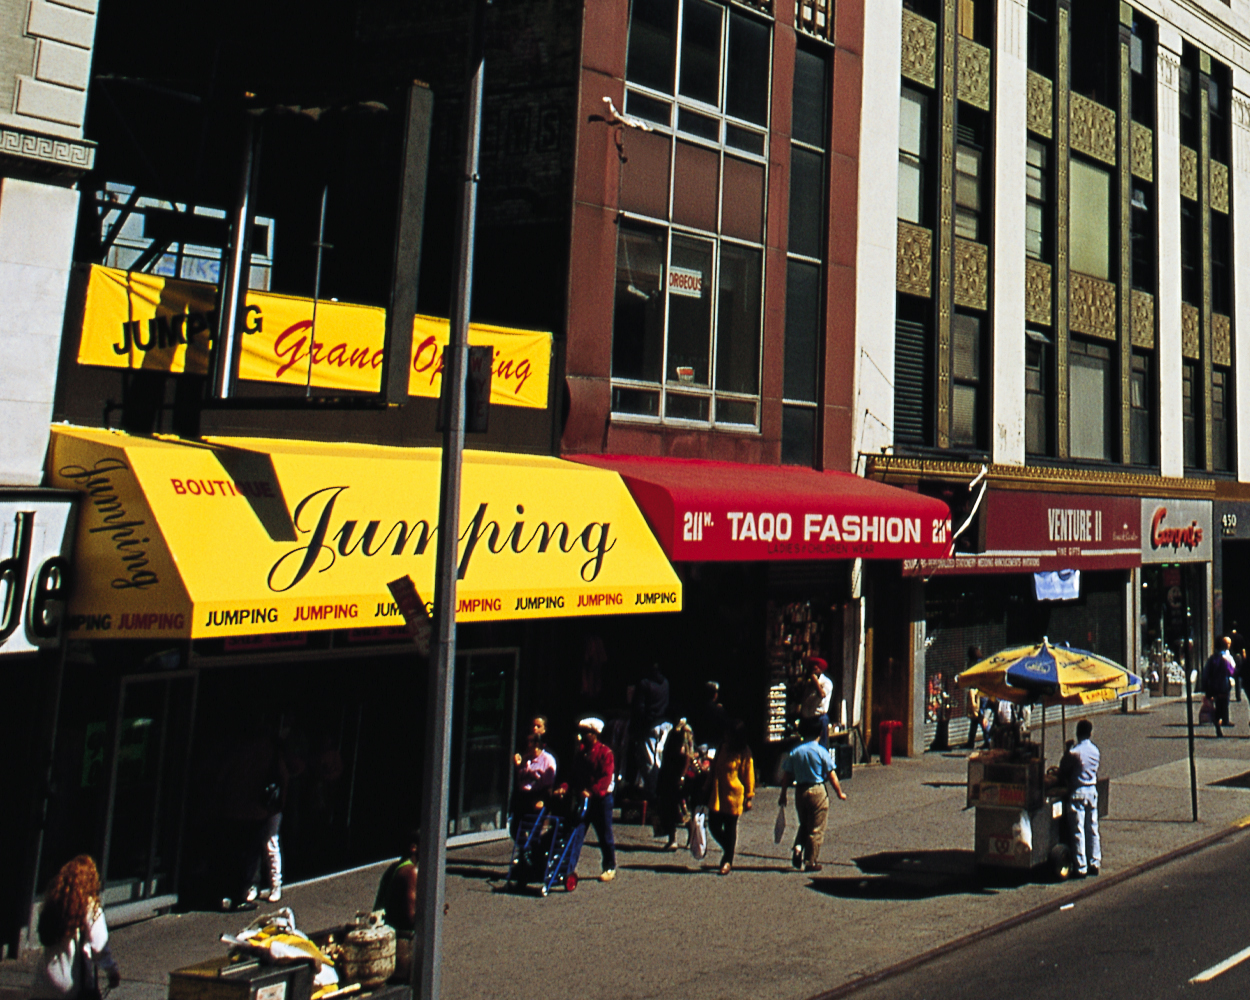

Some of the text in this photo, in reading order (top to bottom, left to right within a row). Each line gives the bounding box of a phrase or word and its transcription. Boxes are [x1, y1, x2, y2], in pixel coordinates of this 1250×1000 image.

[669, 272, 702, 292] ORGEOUS
[113, 304, 263, 355] JUMPG
[413, 335, 532, 395] Oping
[171, 478, 276, 498] BOUTIQUE
[59, 457, 160, 590] Jumping
[727, 511, 793, 543] TAQO
[803, 513, 921, 544] FASHION
[1048, 508, 1102, 542] VENTURE II
[1222, 514, 1237, 527] 450
[118, 613, 184, 630] JUMPING
[205, 607, 278, 626] JUMPING
[293, 604, 359, 621] JUMPING
[456, 598, 502, 613] UMPING
[515, 596, 565, 610] JUMPING
[577, 593, 623, 607] JUMPING
[635, 592, 676, 605] JUMPING
